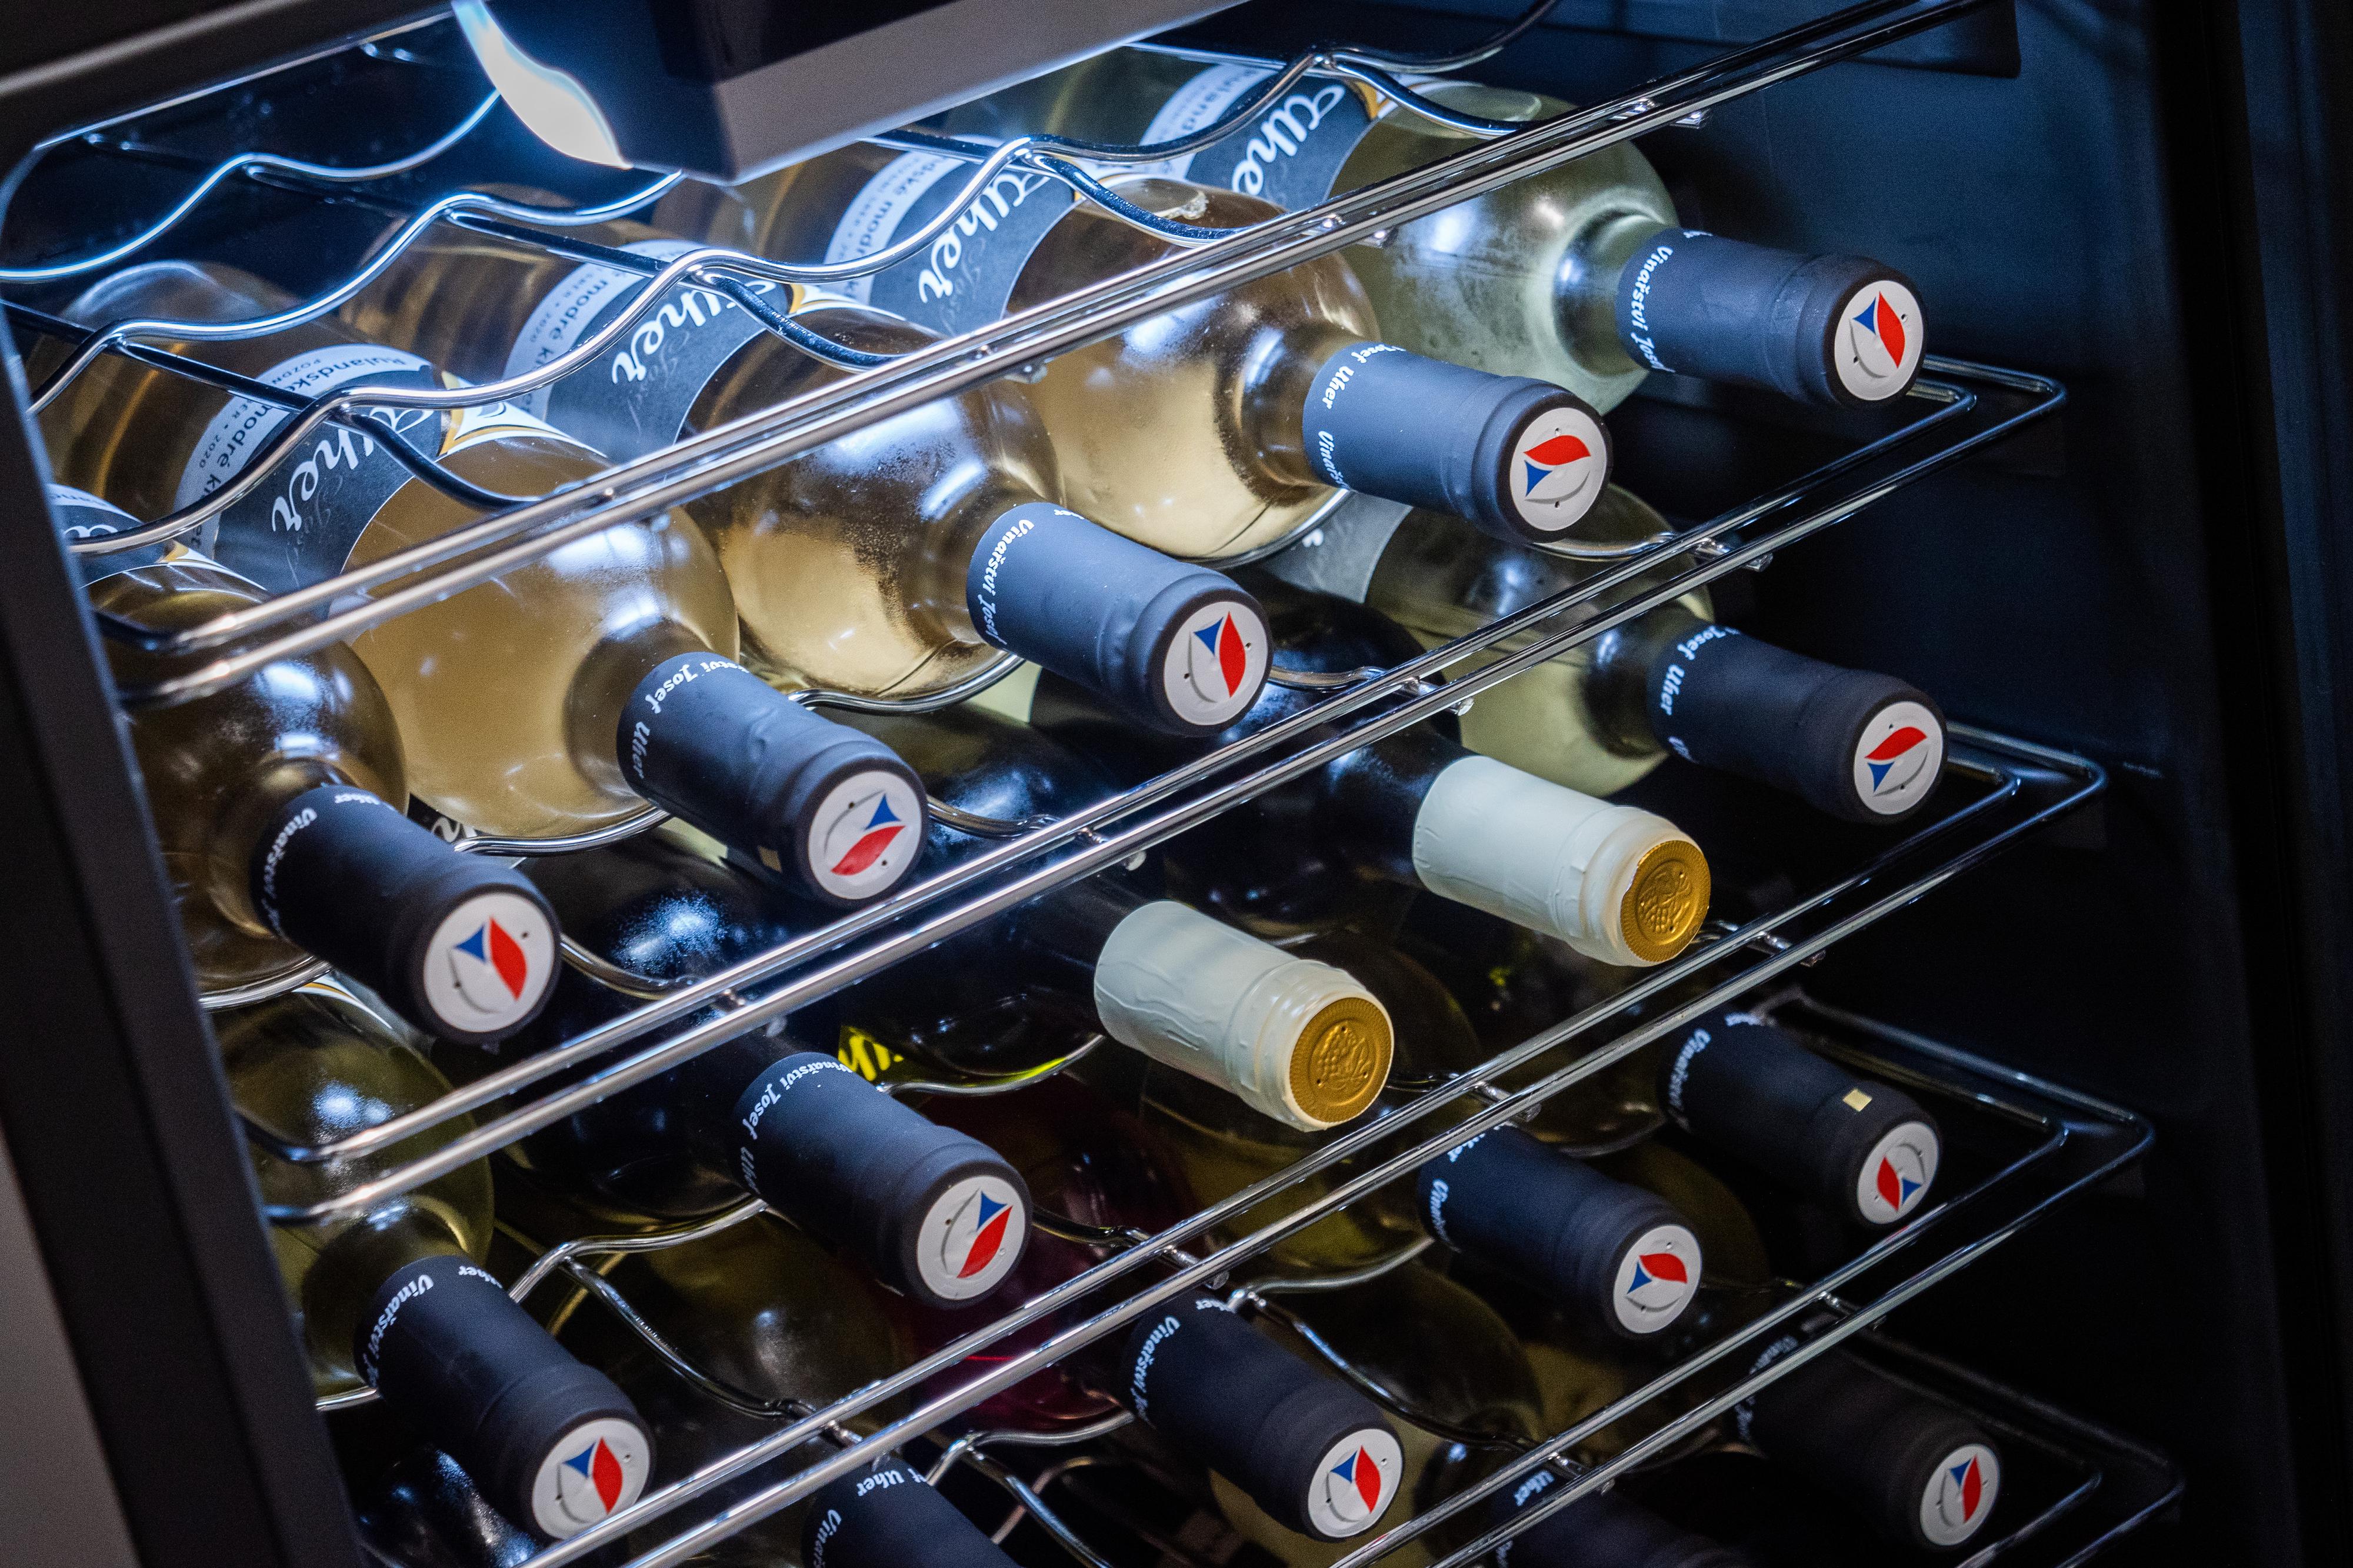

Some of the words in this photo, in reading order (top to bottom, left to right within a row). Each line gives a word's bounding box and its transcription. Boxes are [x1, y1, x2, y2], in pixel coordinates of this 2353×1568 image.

[1322, 365, 1355, 409] Uher
[982, 519, 1035, 596] Vinařství
[645, 663, 699, 715] Josef
[1660, 663, 1685, 716] Uher
[742, 1083, 782, 1140] Josef
[856, 1469, 905, 1497] Uher
